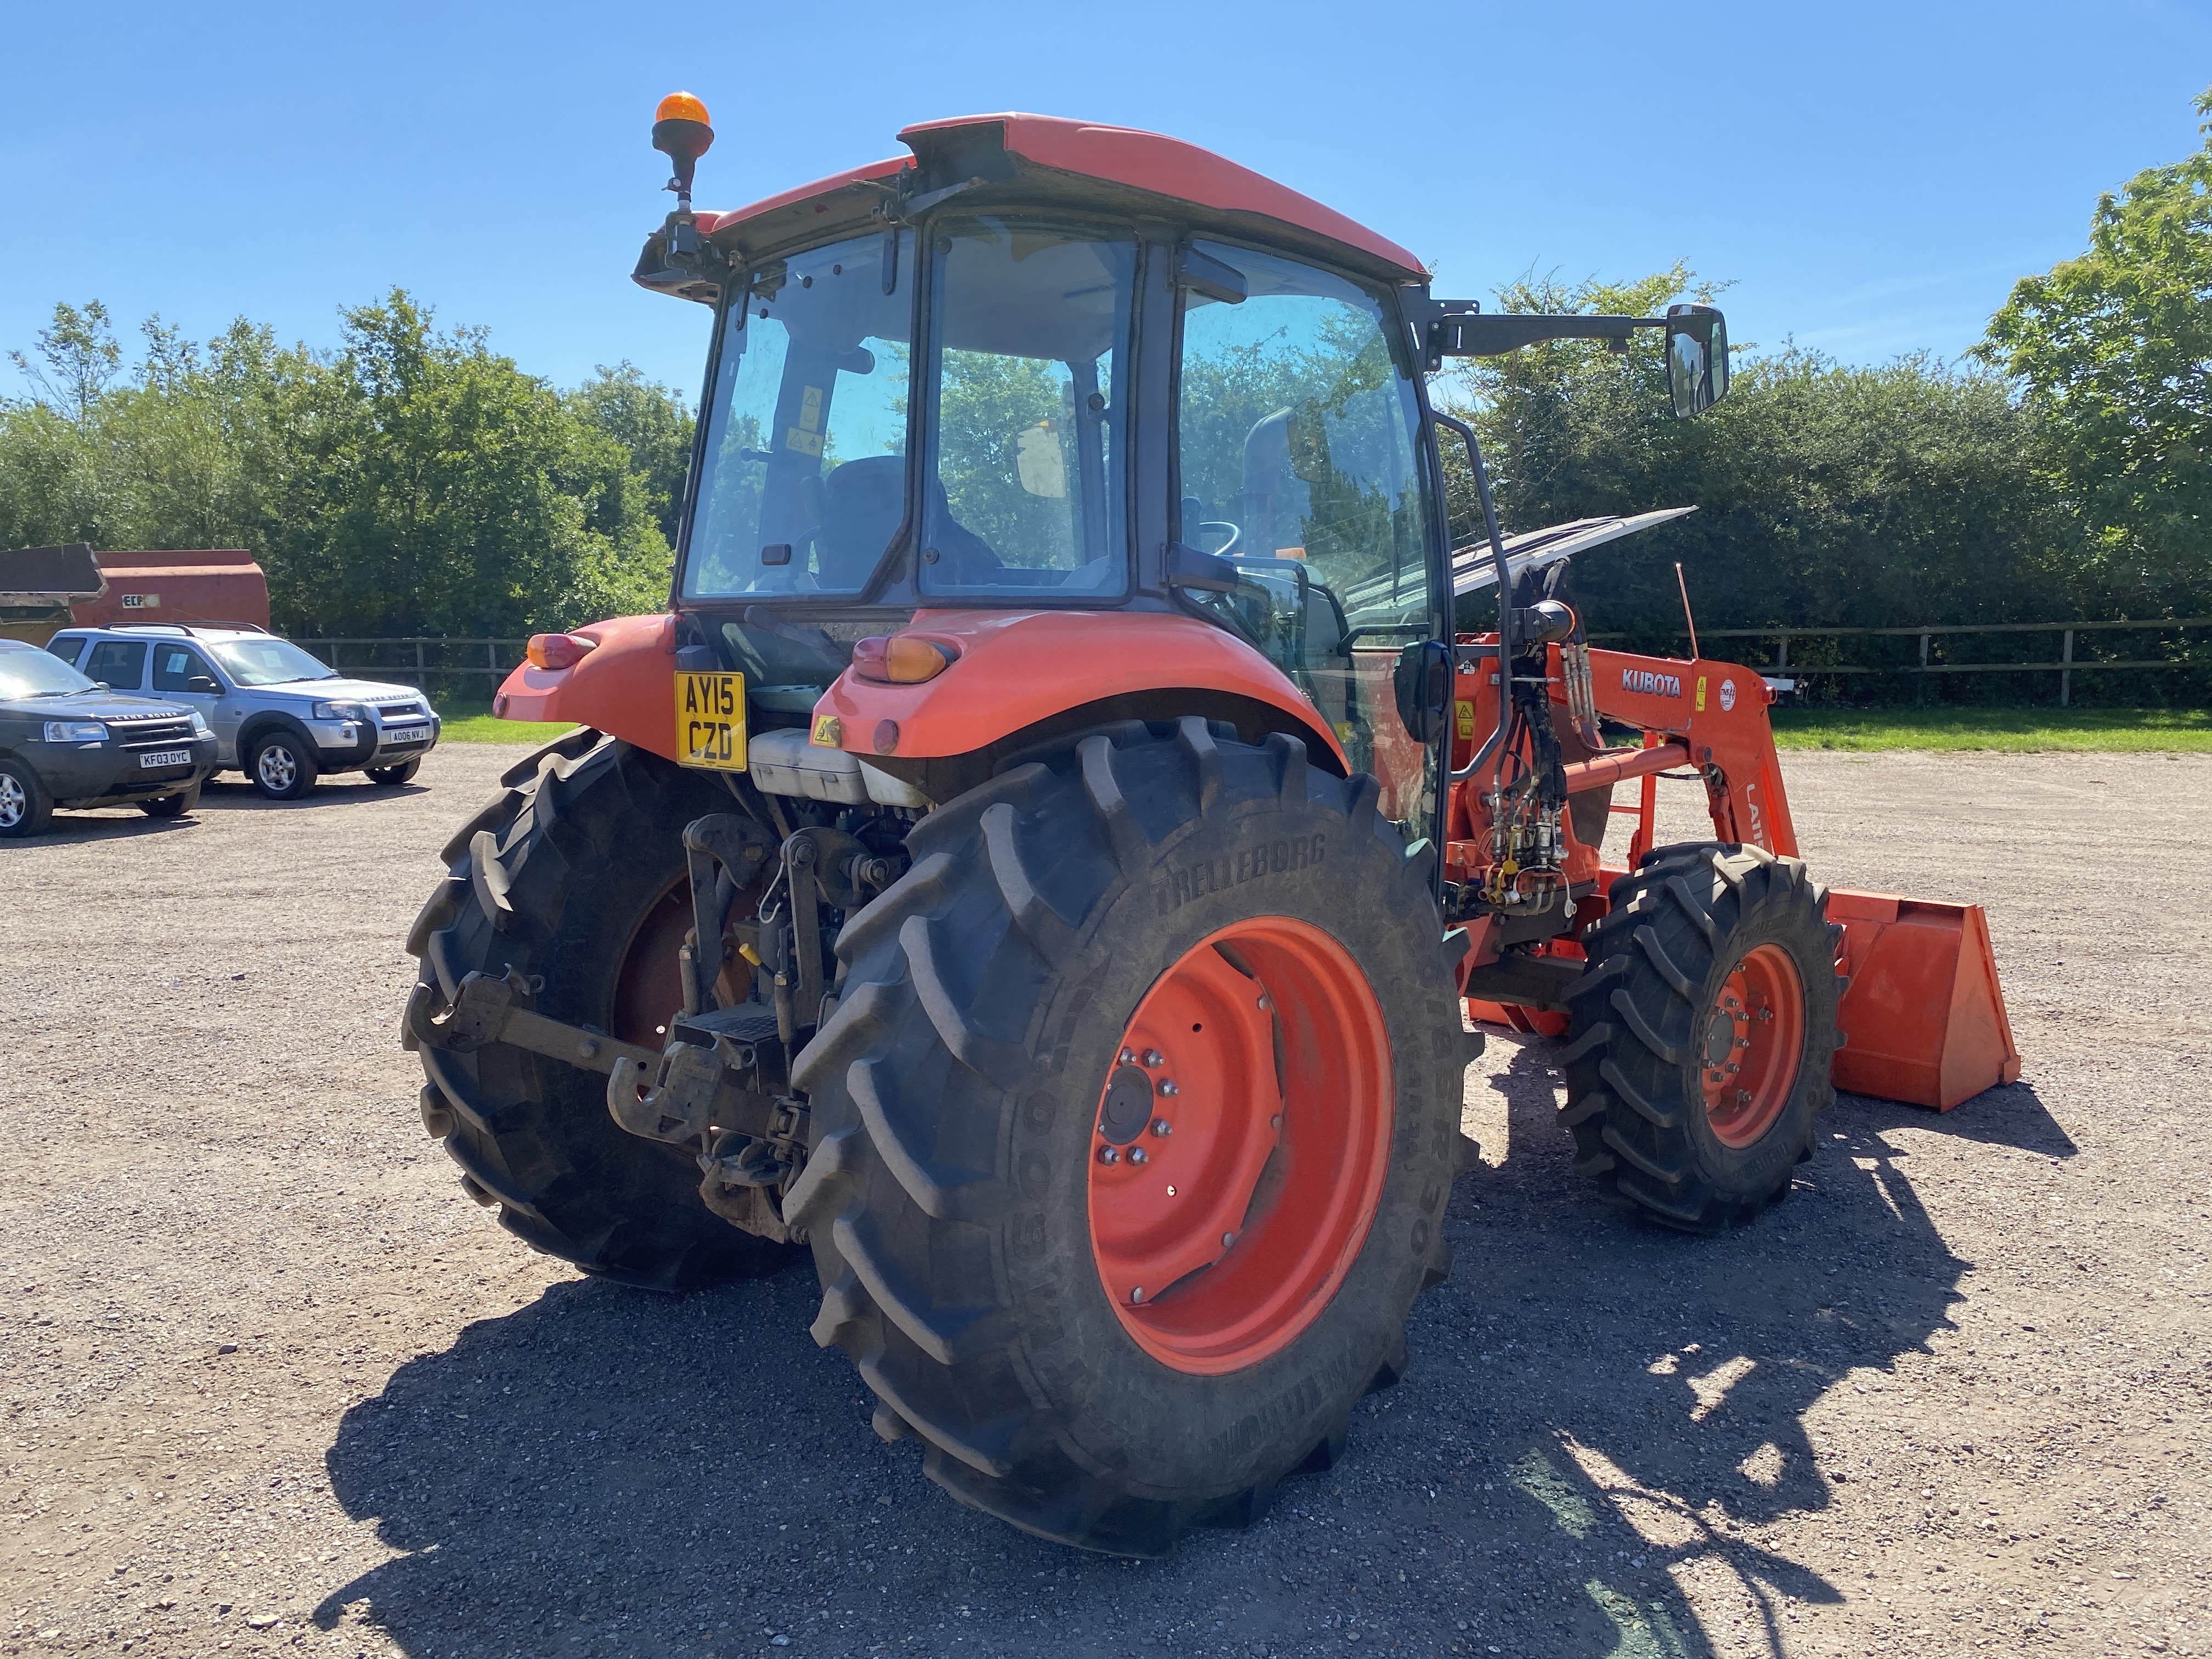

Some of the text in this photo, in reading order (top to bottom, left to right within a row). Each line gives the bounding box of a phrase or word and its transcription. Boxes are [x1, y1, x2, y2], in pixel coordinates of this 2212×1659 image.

[686, 676, 733, 715] AY15
[1622, 668, 1681, 698] KUBOTA
[412, 730, 424, 738] NVJ
[689, 720, 732, 761] CZD
[144, 752, 187, 765] KF03 OYC
[1148, 832, 1326, 917] TRELLEBORG
